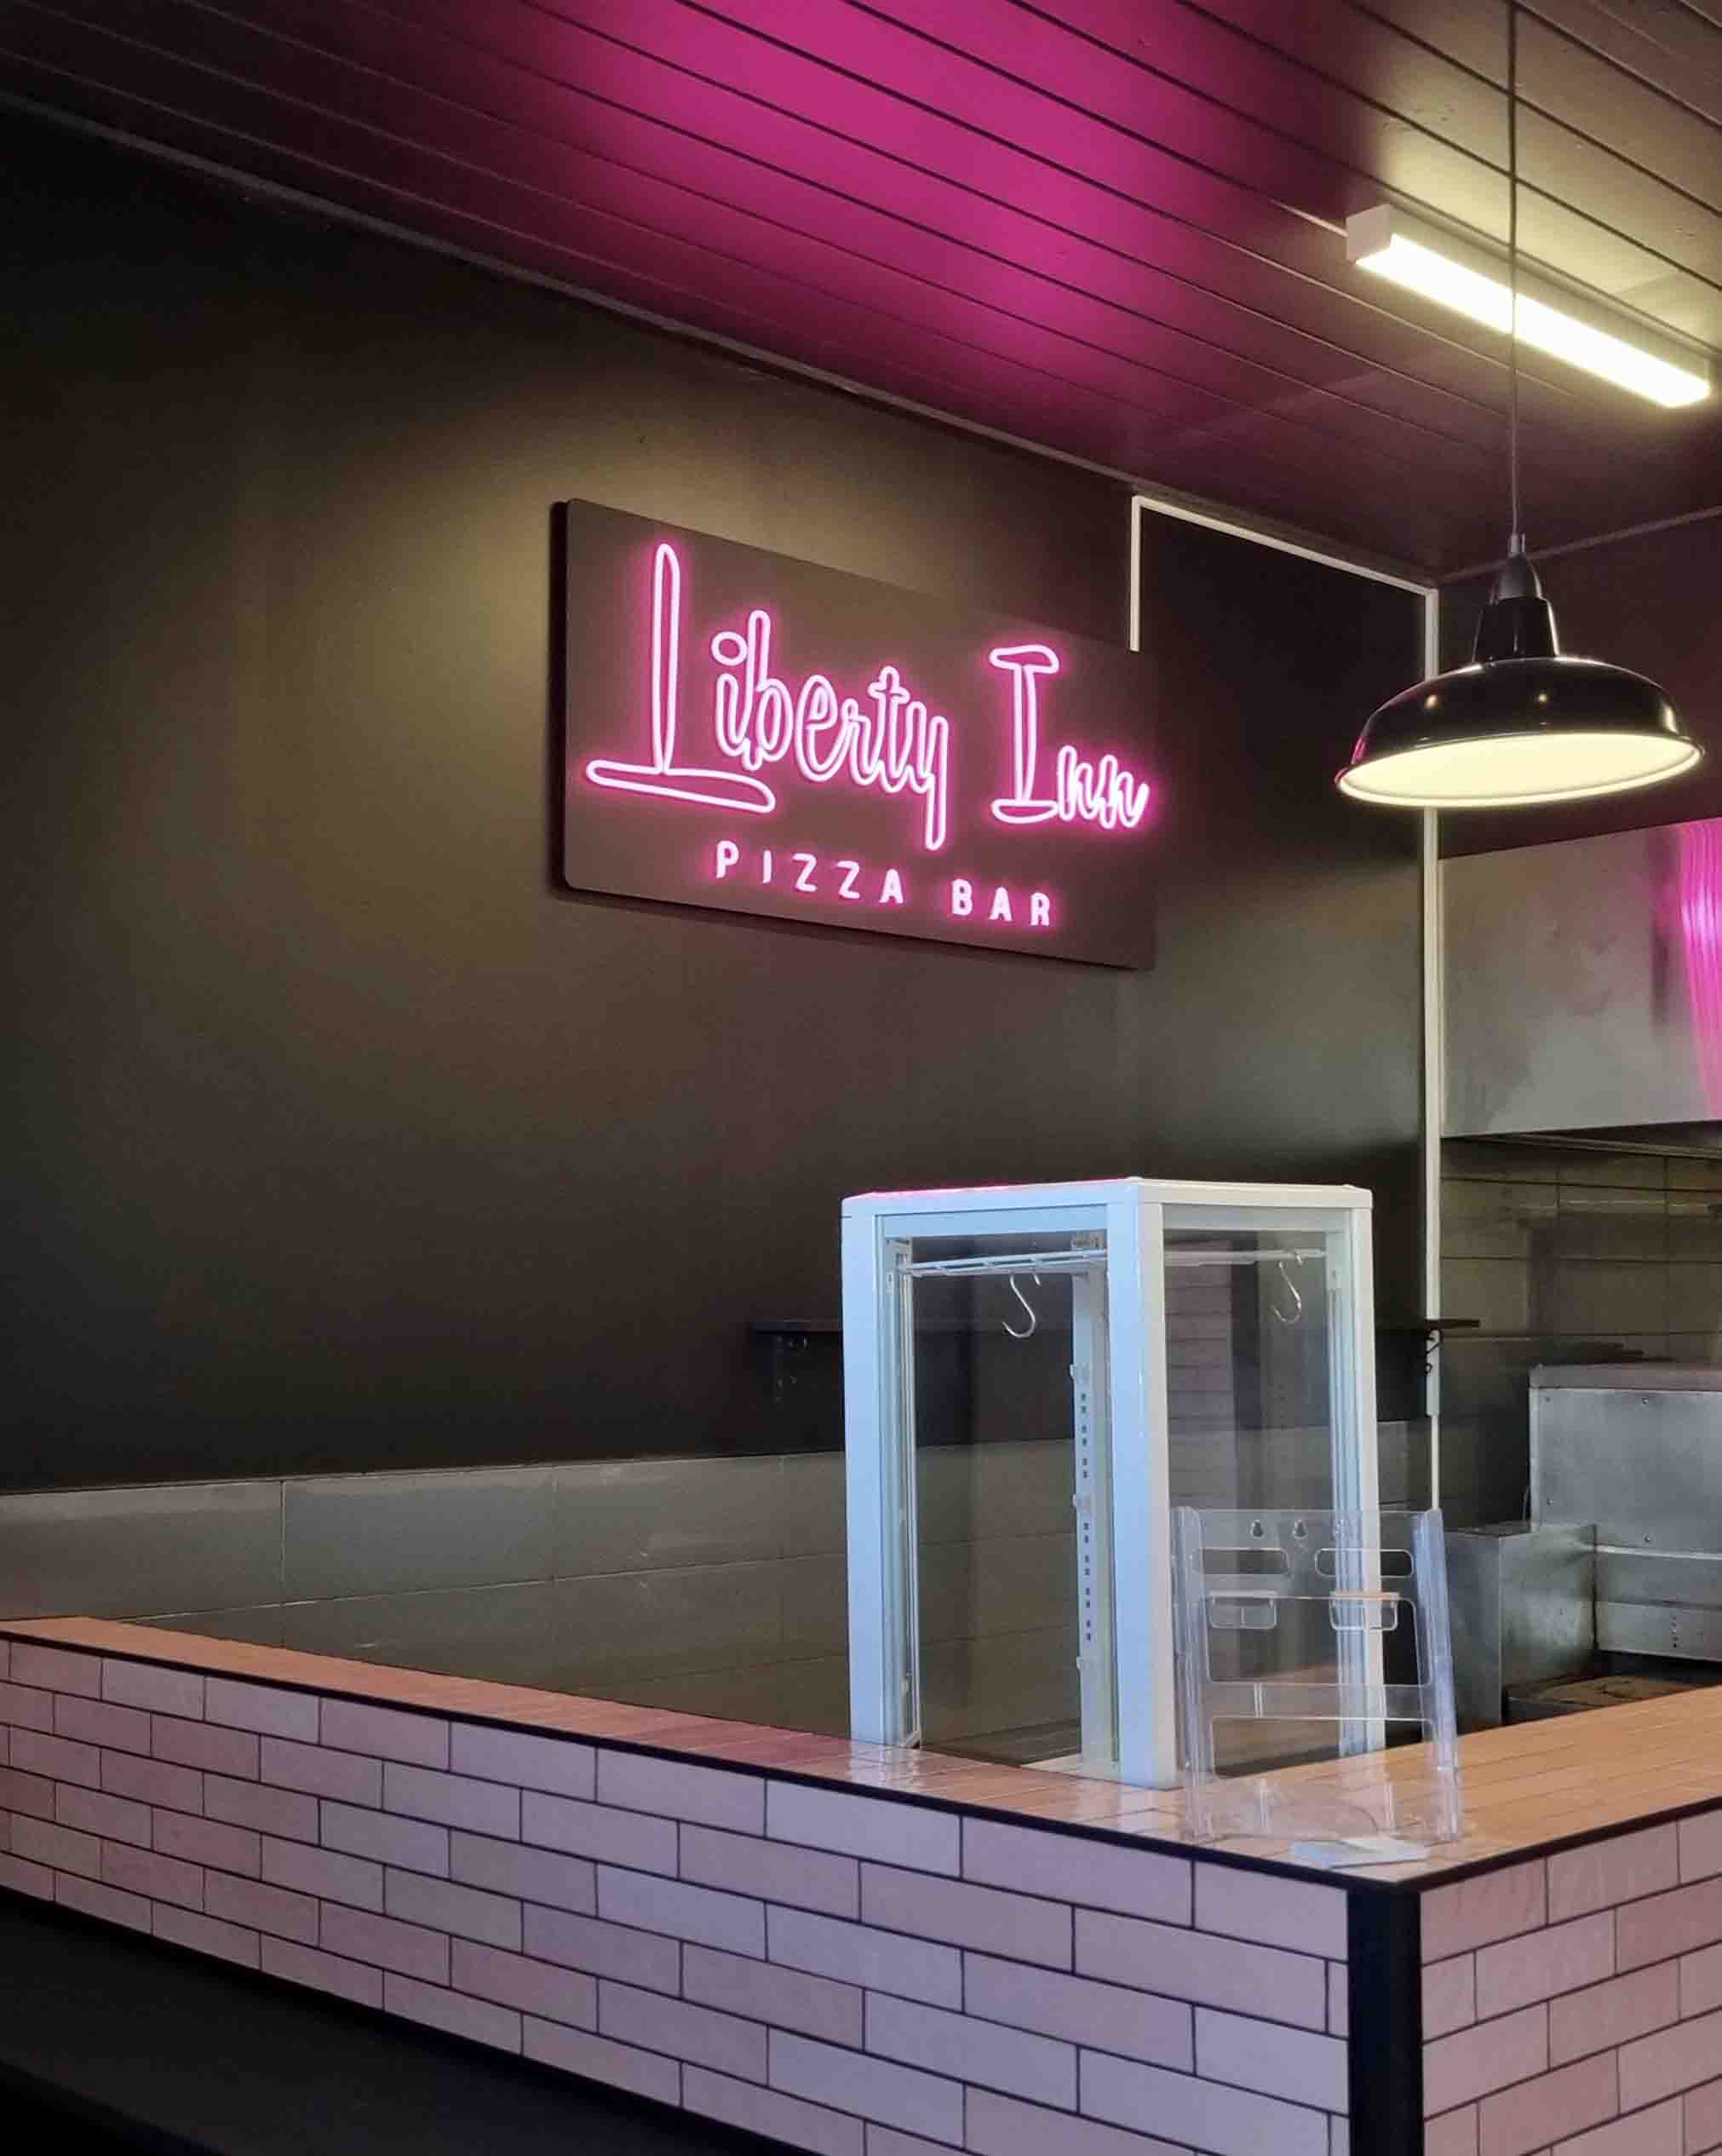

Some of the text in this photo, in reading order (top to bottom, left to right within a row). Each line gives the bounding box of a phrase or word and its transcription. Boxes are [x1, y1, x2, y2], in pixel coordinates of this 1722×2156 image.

[587, 543, 1150, 850] Liberty Inn
[715, 841, 1051, 927] PIZZA BAR
